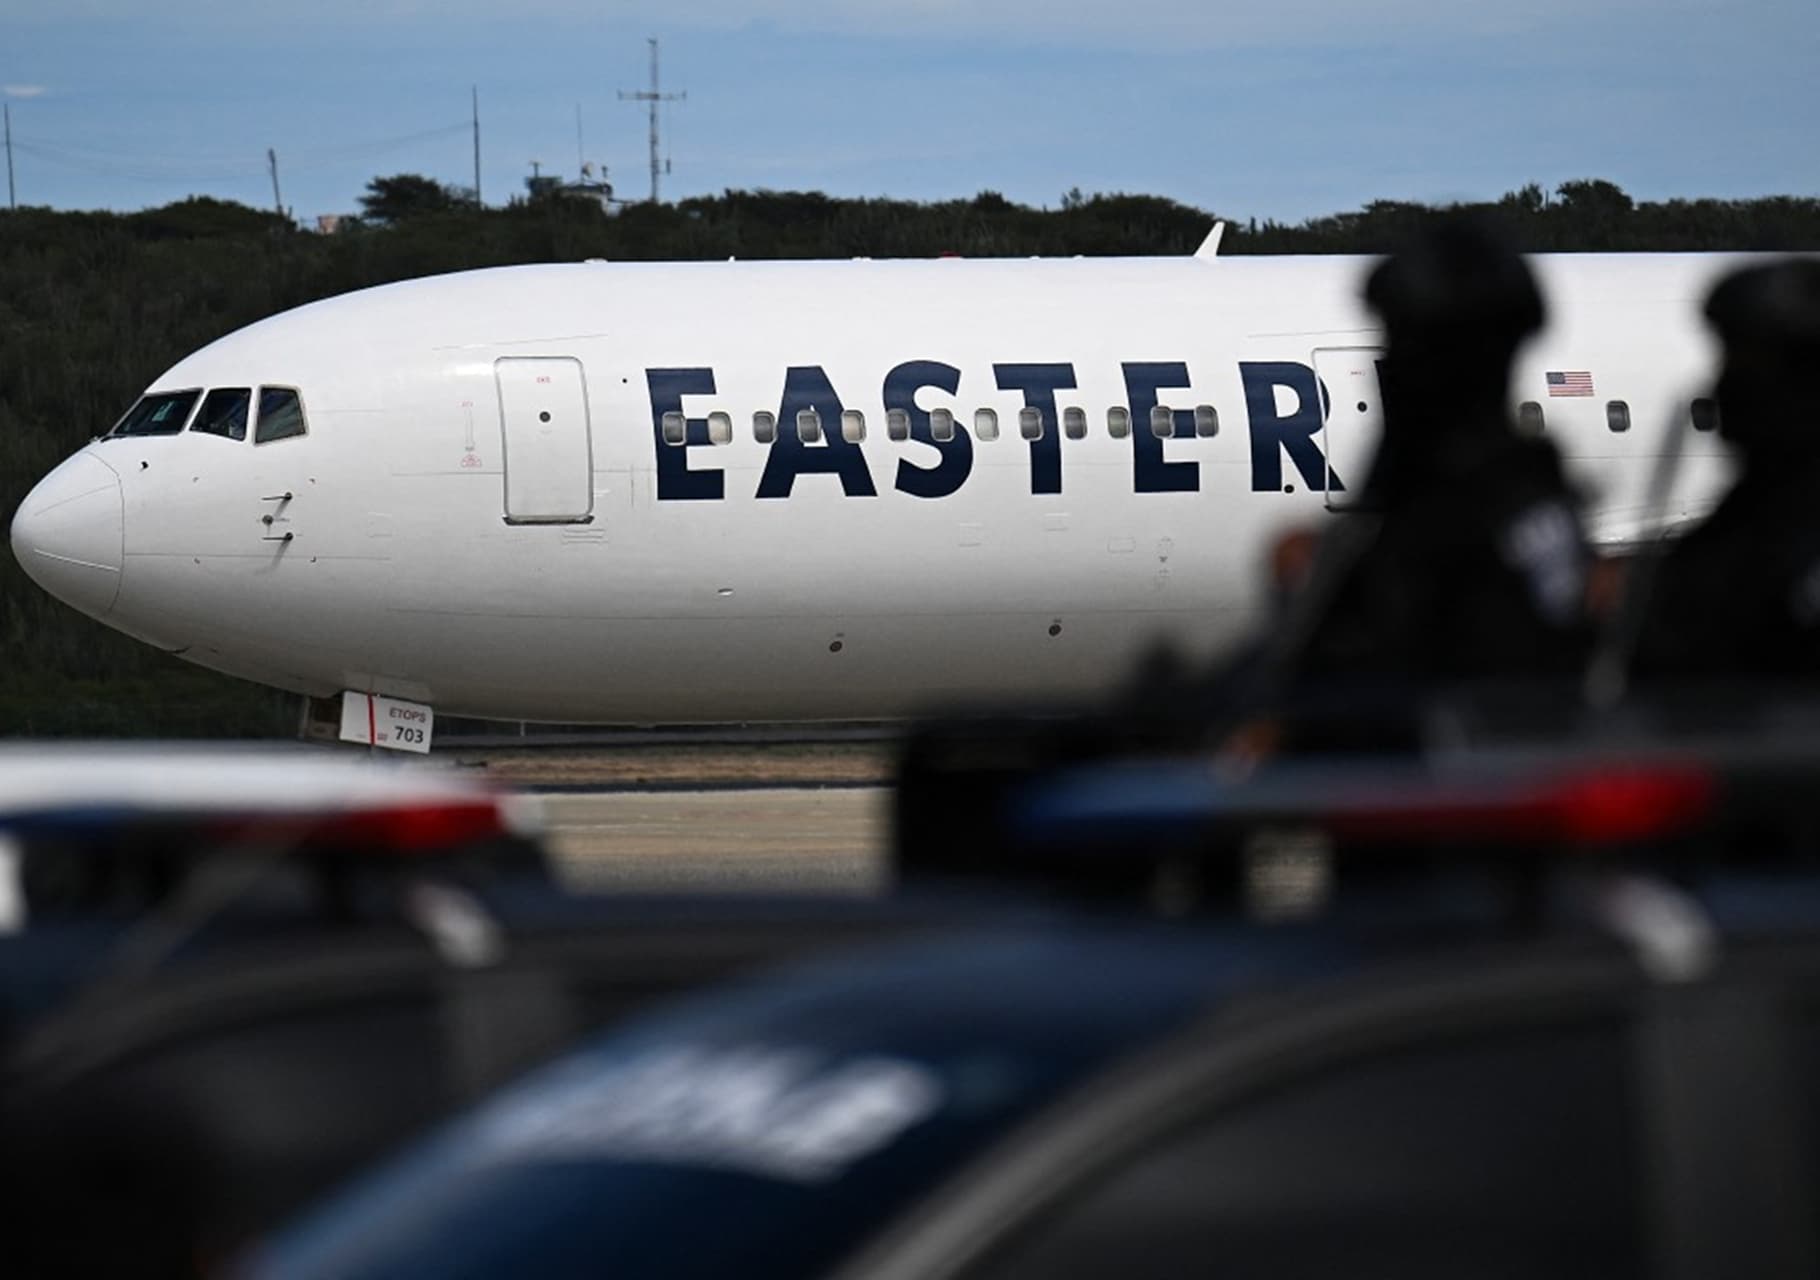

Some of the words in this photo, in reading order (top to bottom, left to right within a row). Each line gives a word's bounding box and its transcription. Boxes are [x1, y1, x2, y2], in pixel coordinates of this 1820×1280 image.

[645, 359, 1387, 500] EASTER
[389, 707, 426, 723] ETOPS
[395, 726, 424, 743] 703
